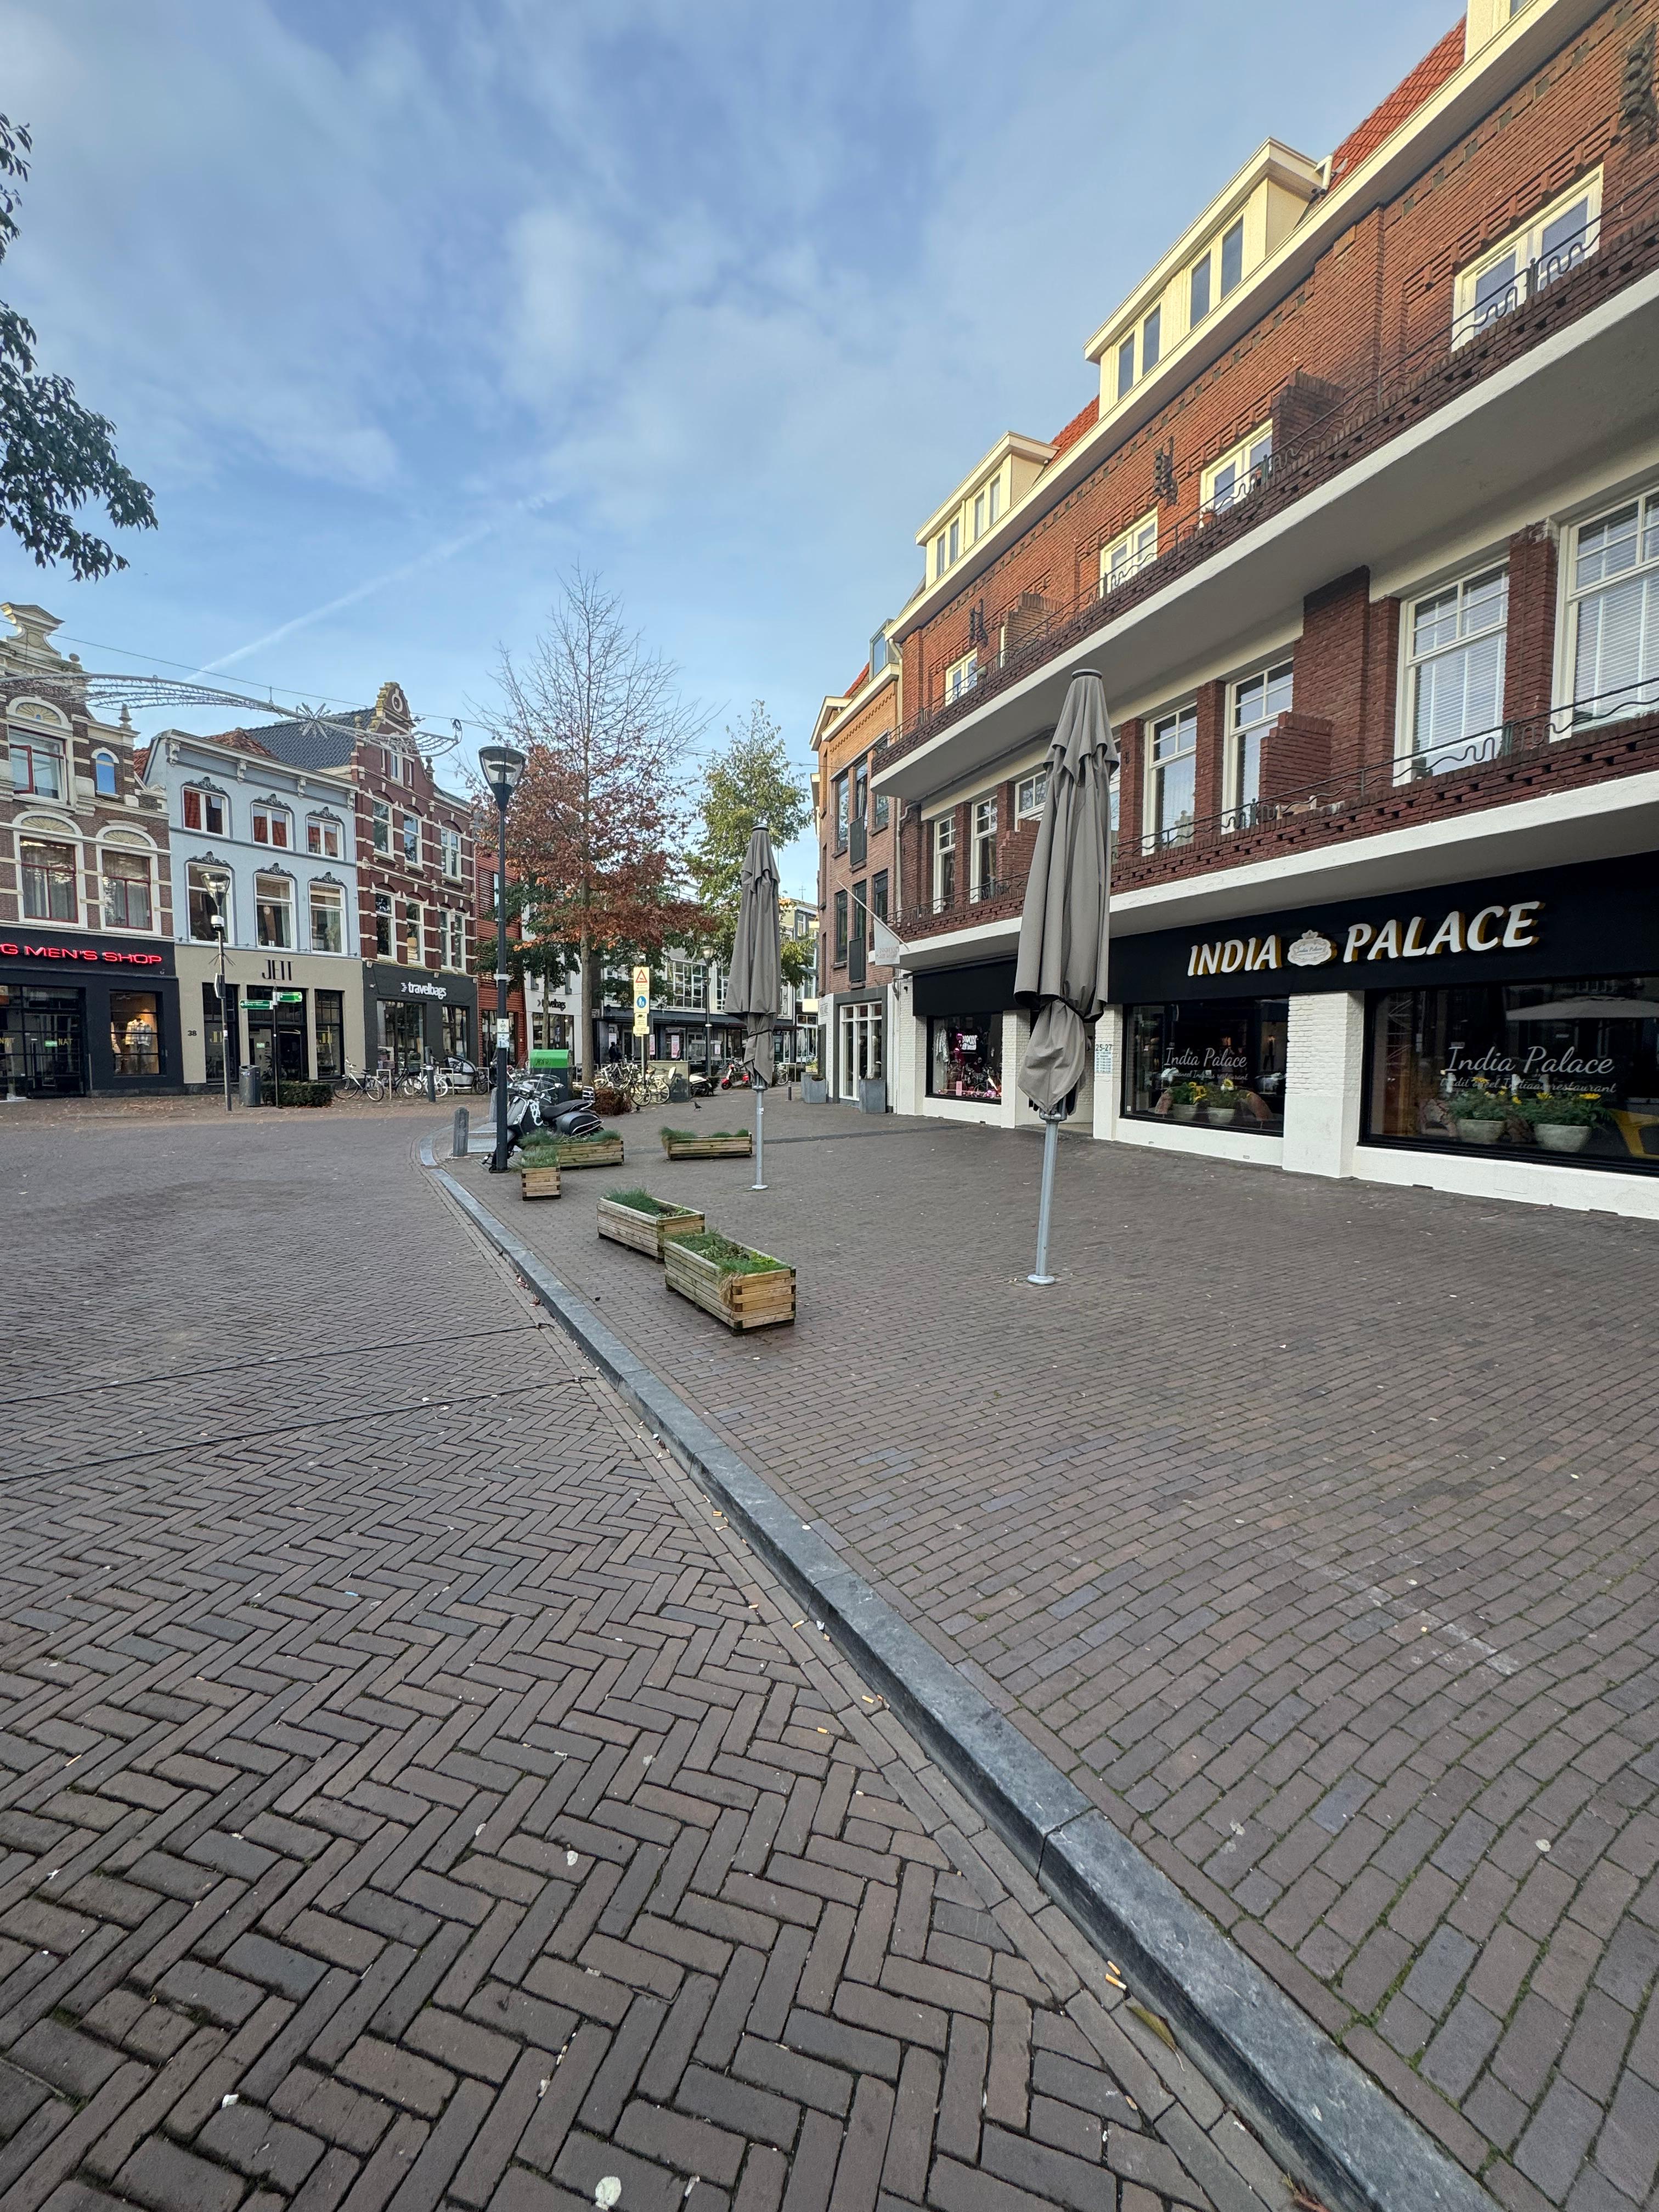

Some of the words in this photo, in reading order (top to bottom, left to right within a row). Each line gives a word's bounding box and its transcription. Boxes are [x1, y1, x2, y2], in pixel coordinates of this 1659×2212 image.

[1187, 935, 1279, 976] INDIA
[1343, 901, 1542, 963] PALACE
[24, 945, 98, 961] MEN'S
[102, 952, 162, 964] SHOP
[408, 981, 447, 1000] travelbags
[541, 998, 566, 1012] tvelbags
[1163, 1047, 1200, 1066] India
[1203, 1047, 1248, 1068] Palace
[1444, 1046, 1516, 1071] India
[1522, 1046, 1615, 1074] Palace
